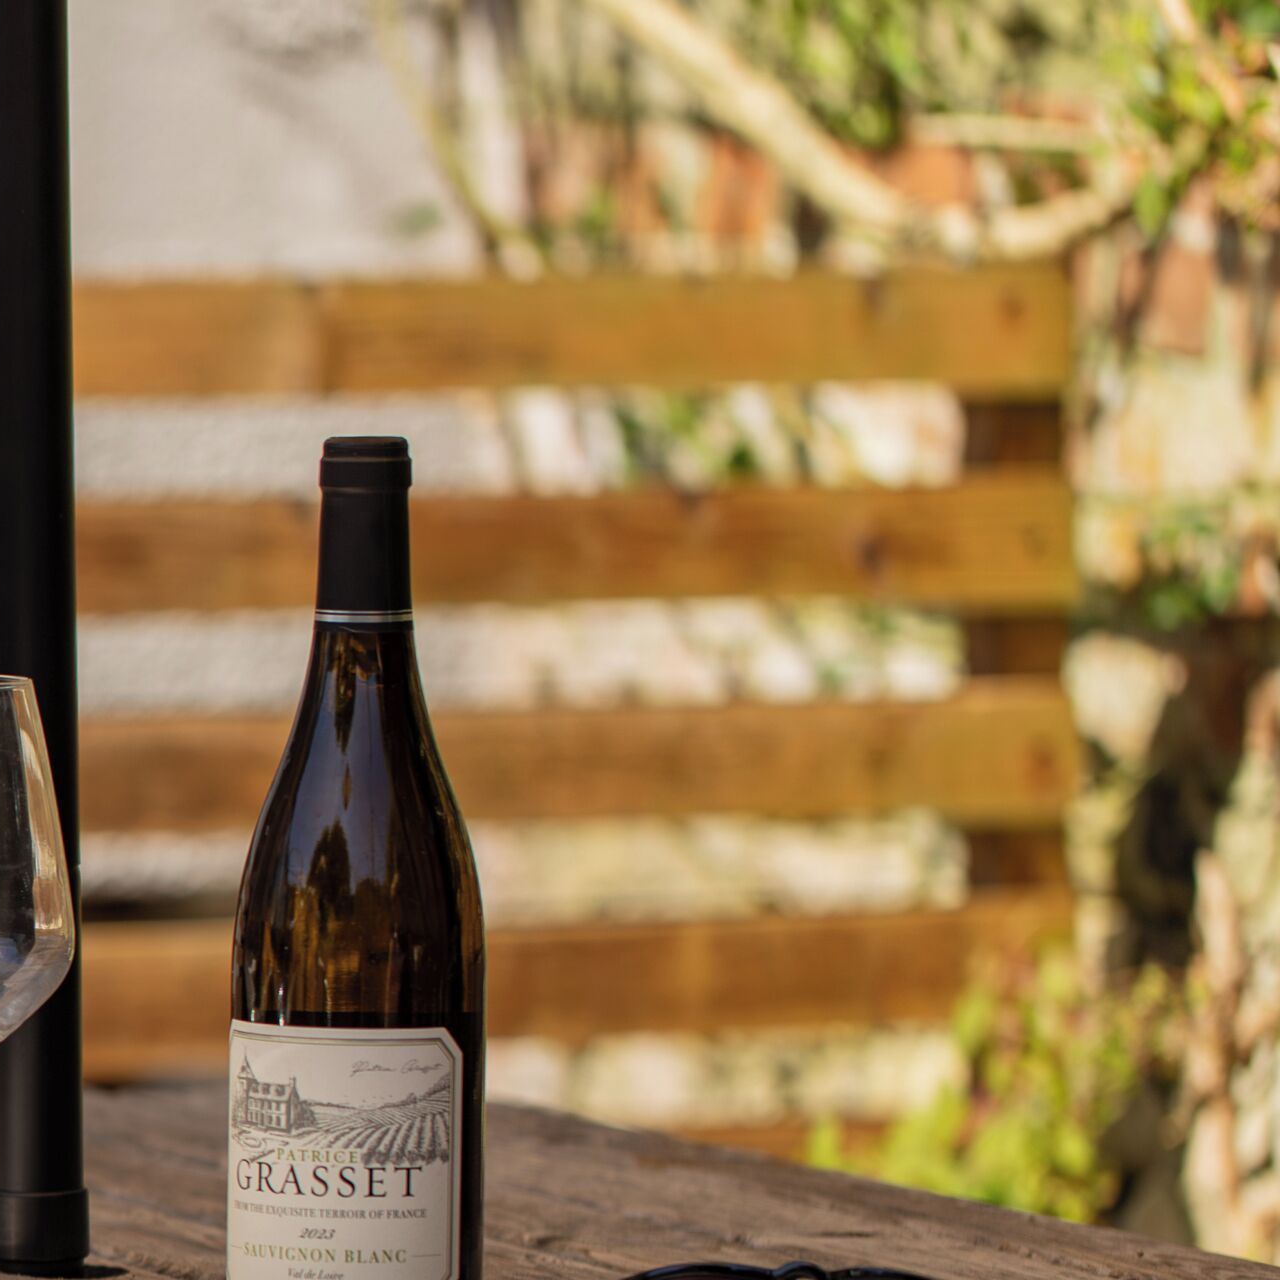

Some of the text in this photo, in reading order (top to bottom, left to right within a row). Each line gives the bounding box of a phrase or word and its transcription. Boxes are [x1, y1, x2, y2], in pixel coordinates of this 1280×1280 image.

[276, 1148, 359, 1164] PATRICE
[236, 1158, 422, 1198] GRASSET
[250, 1202, 264, 1213] THE
[265, 1203, 315, 1218] EXQUISITE
[319, 1208, 366, 1219] TERROIR
[368, 1208, 383, 1220] OF
[386, 1208, 427, 1219] FRANCE
[299, 1227, 336, 1240] 2023
[243, 1242, 407, 1264] SAUVIGNON BLANC
[287, 1268, 344, 1280] Val de Loire
